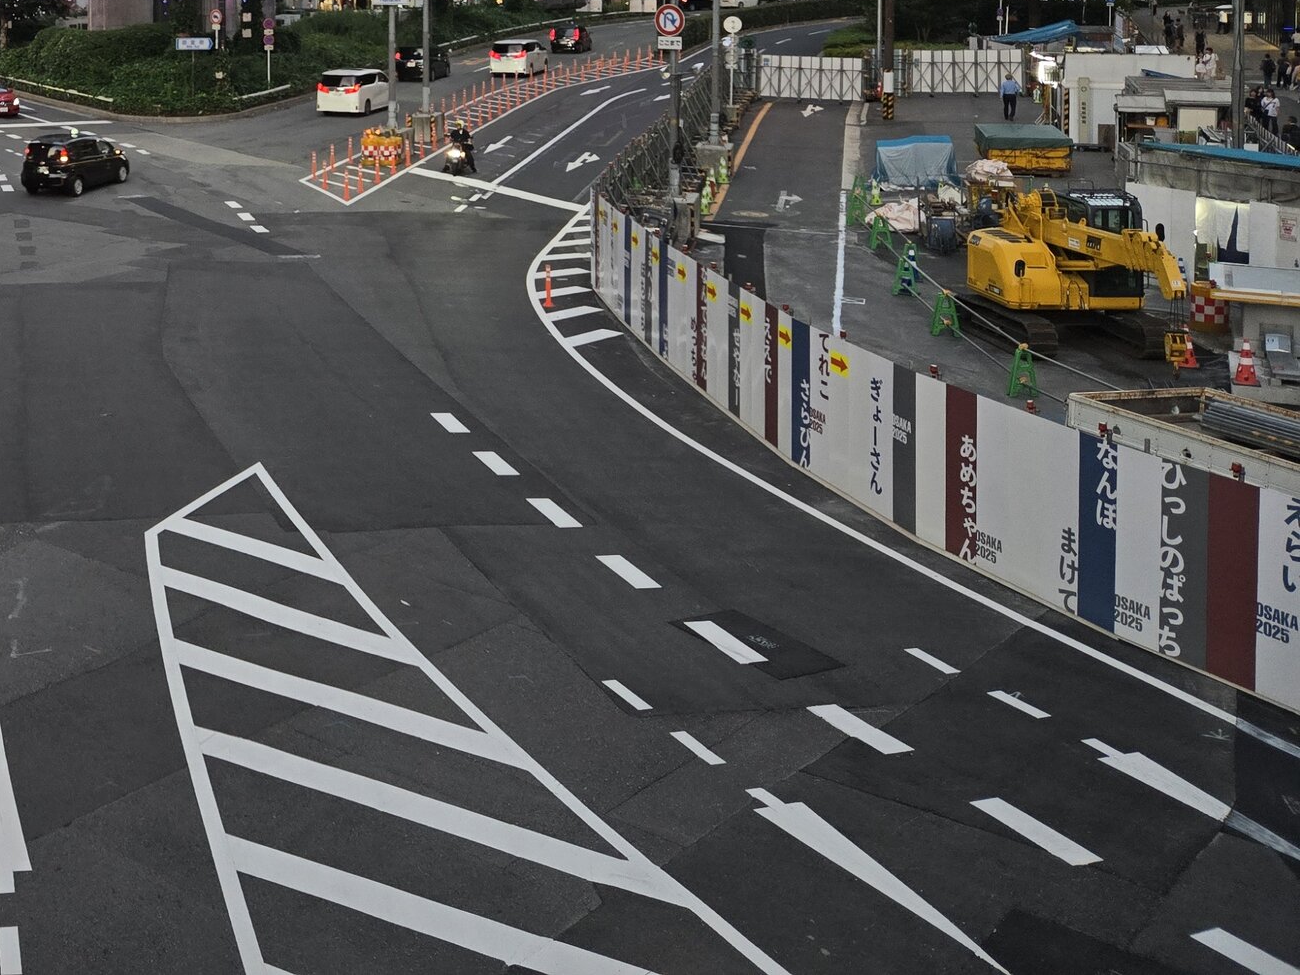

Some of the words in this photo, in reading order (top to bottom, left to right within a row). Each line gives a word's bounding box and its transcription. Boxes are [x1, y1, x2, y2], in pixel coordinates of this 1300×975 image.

[818, 333, 830, 401] てれこ
[870, 377, 884, 495] ぎょーさん
[892, 413, 912, 434] OSAKA
[892, 427, 908, 445] 2025
[958, 434, 977, 565] あめちゃん
[1096, 439, 1118, 531] なんぼ
[975, 529, 1003, 553] OSAKA
[975, 544, 997, 564] 2025
[1058, 527, 1079, 615] まけて
[1158, 461, 1187, 658] ひっしのぱっち
[1113, 609, 1143, 633] 2025
[1114, 593, 1151, 621] OSAKA
[1255, 601, 1299, 632] OSAKA
[1255, 618, 1290, 644] 2025
